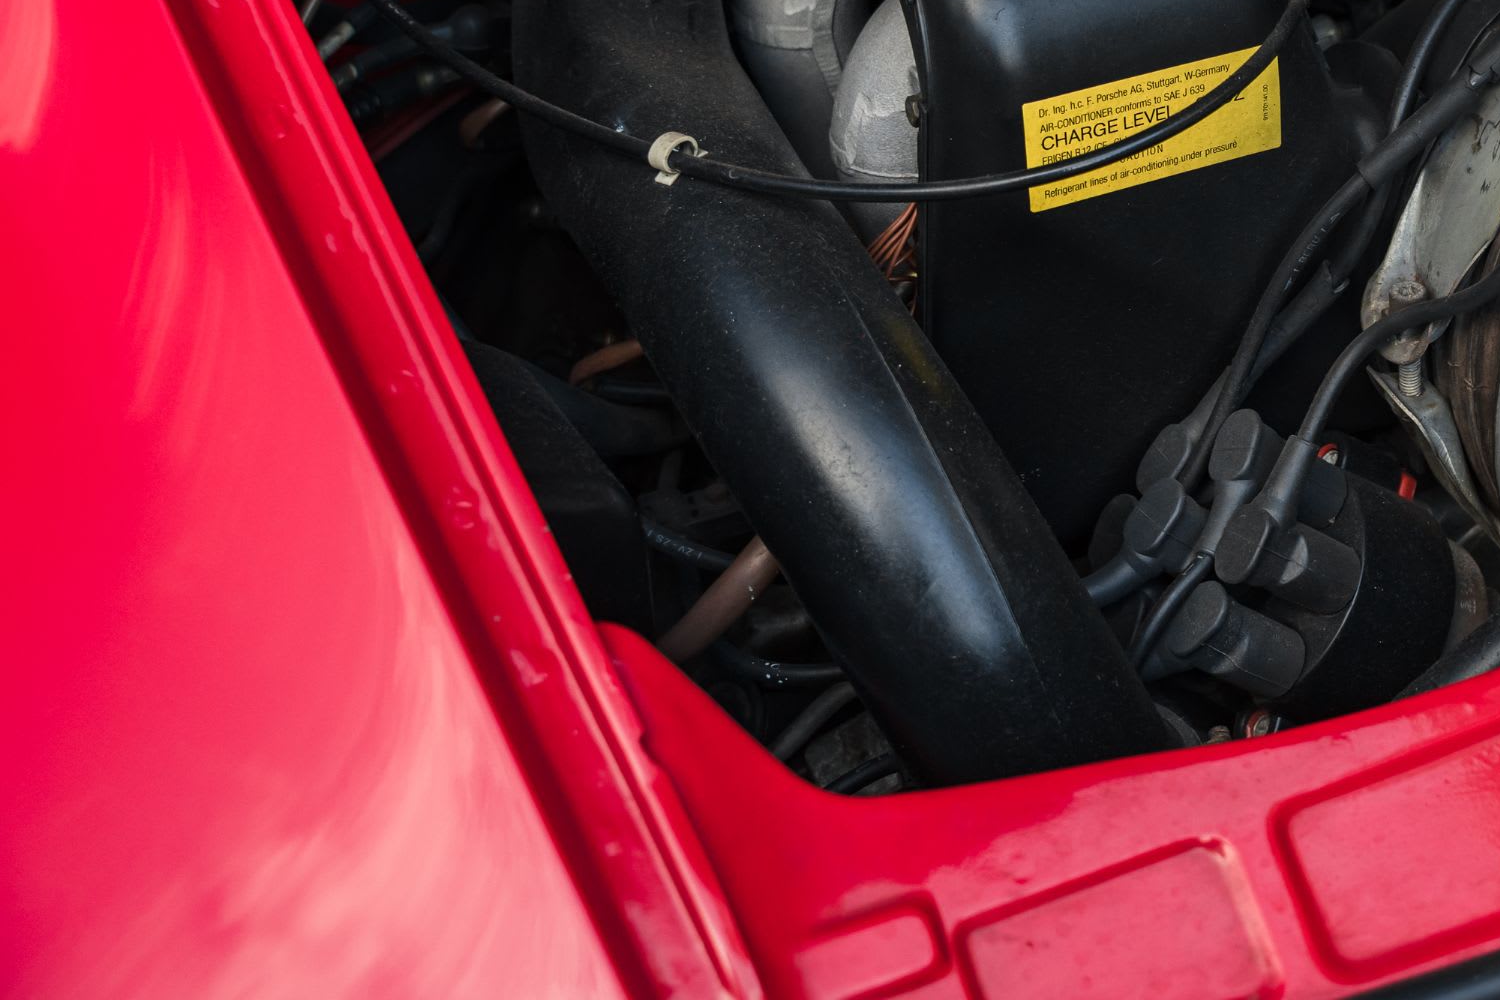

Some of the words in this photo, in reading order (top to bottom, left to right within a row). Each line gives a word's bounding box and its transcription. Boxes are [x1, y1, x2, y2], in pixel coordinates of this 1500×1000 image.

[1038, 108, 1050, 118] Dr.
[1052, 104, 1067, 114] Ing.
[1069, 100, 1083, 110] h.c.
[1086, 96, 1094, 105] F.
[1096, 89, 1127, 103] Porsche
[1129, 83, 1144, 94] AG,
[1146, 74, 1182, 90] Stuttgart,
[1183, 63, 1230, 80] W-Germany
[1039, 106, 1113, 133] AIR-CONDITIONER
[1114, 98, 1151, 114] conforms
[1153, 96, 1161, 104] to
[1163, 89, 1180, 101] SAE
[1182, 87, 1187, 97] J
[1189, 83, 1205, 95] 639
[1040, 118, 1118, 150] CHARGE
[1044, 180, 1087, 199] Refrigerant
[1089, 175, 1108, 186] lines
[1109, 171, 1117, 181] of
[1119, 156, 1178, 178] air-conditioning
[1180, 150, 1202, 162] under
[1204, 140, 1237, 157] pressure
